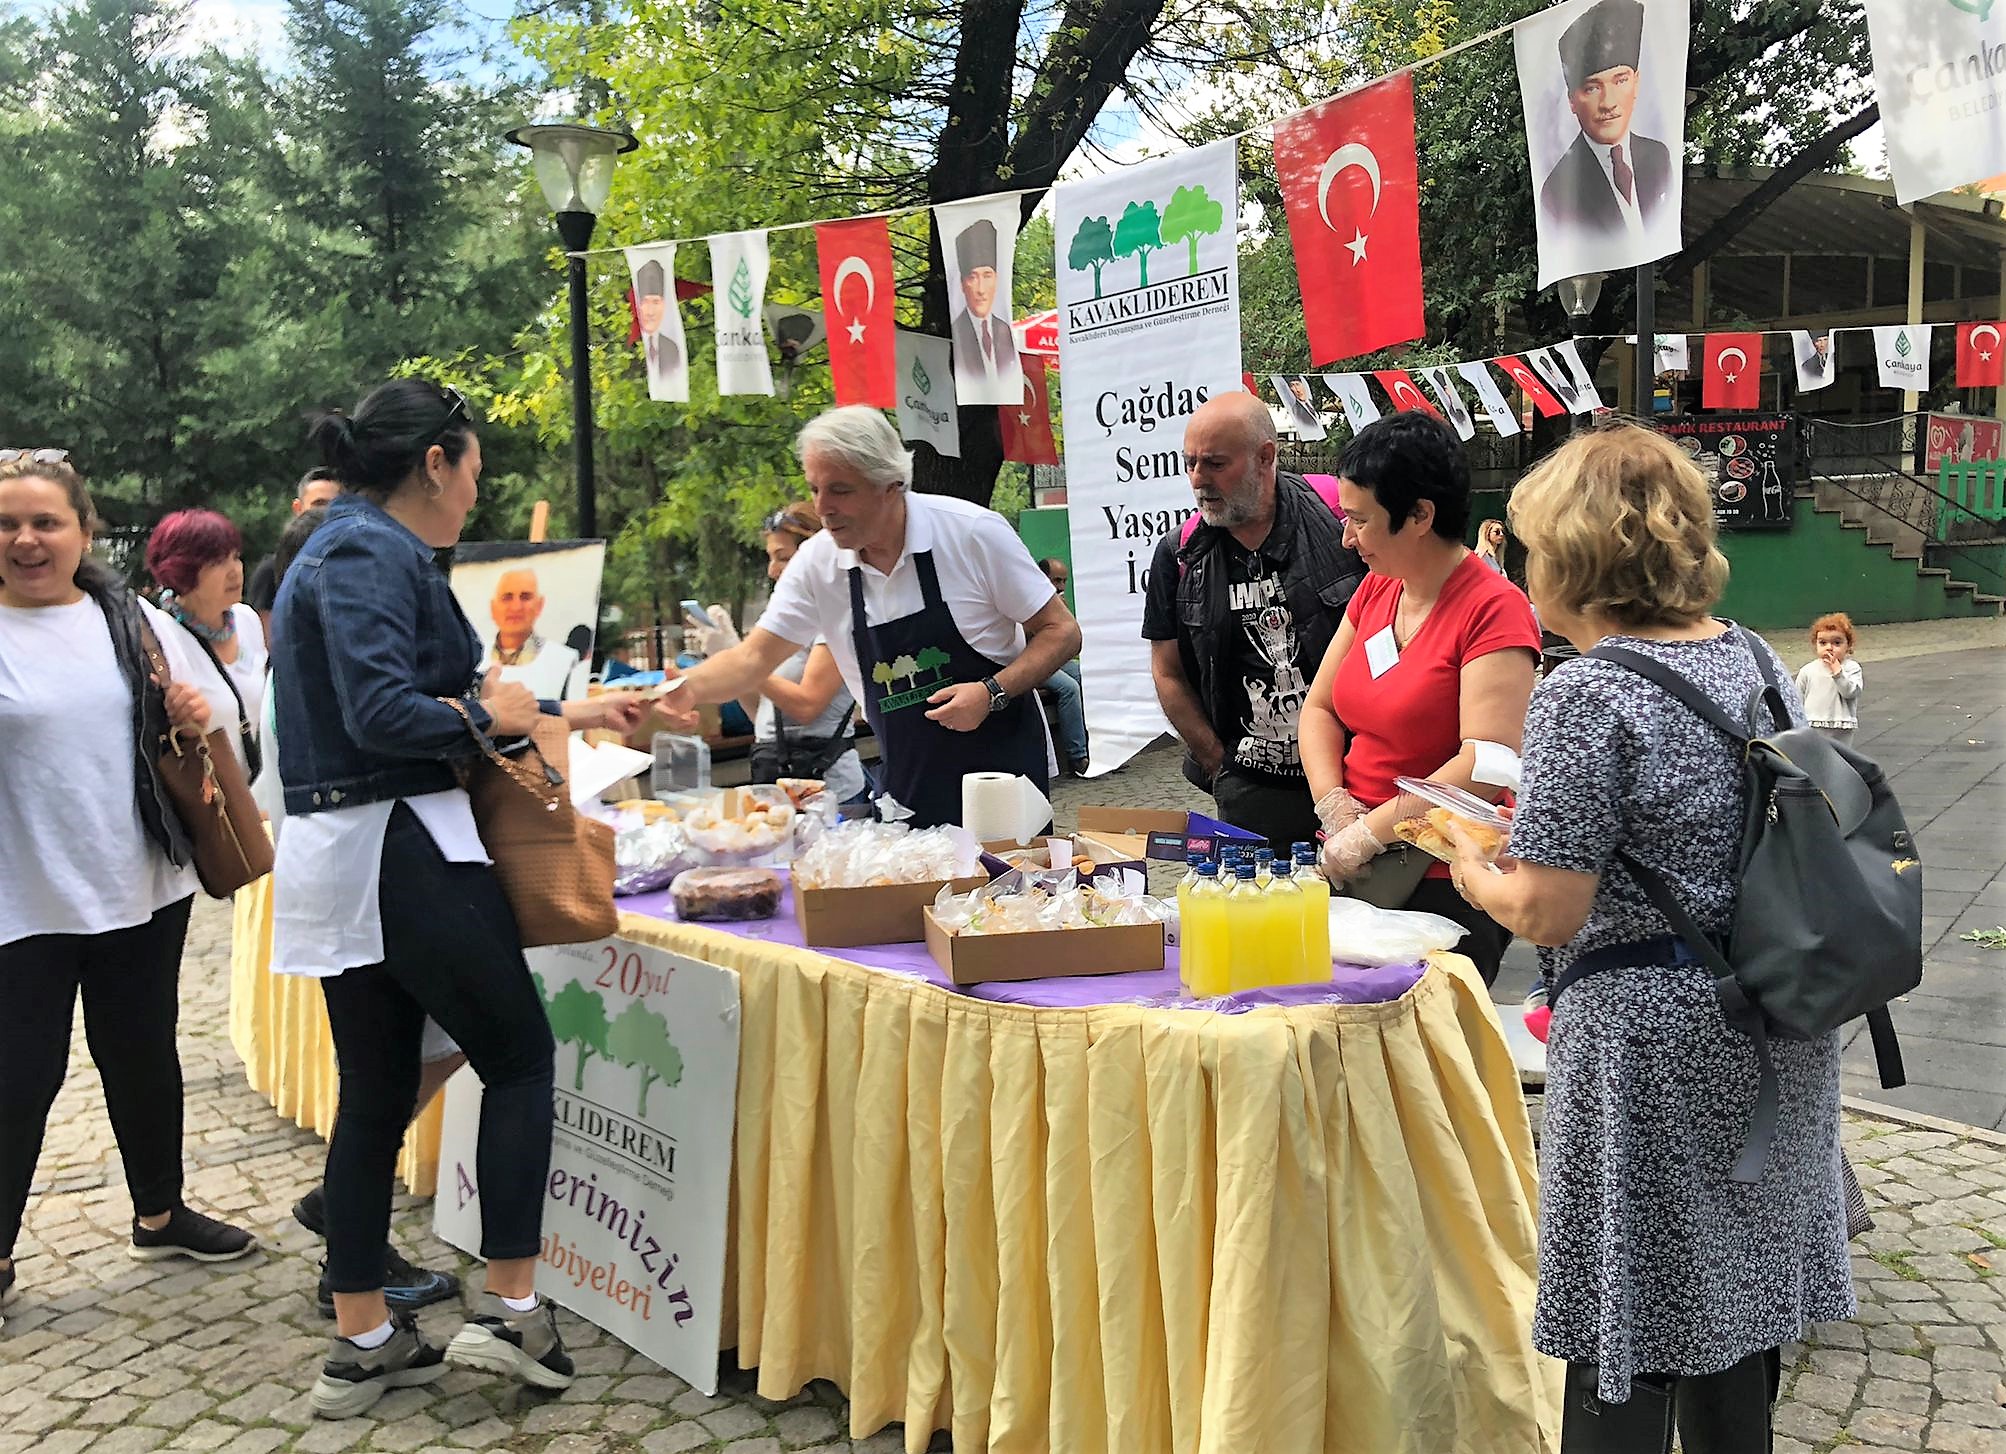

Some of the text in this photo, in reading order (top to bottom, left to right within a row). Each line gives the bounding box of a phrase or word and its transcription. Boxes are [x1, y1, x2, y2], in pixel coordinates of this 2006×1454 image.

[1069, 273, 1229, 329] KAVAKLIDEREM
[1145, 321, 1152, 330] ve
[1202, 303, 1230, 317] Derneği
[1700, 420, 1787, 433] RESTAURANT
[536, 1231, 653, 1321] abiyeleri
